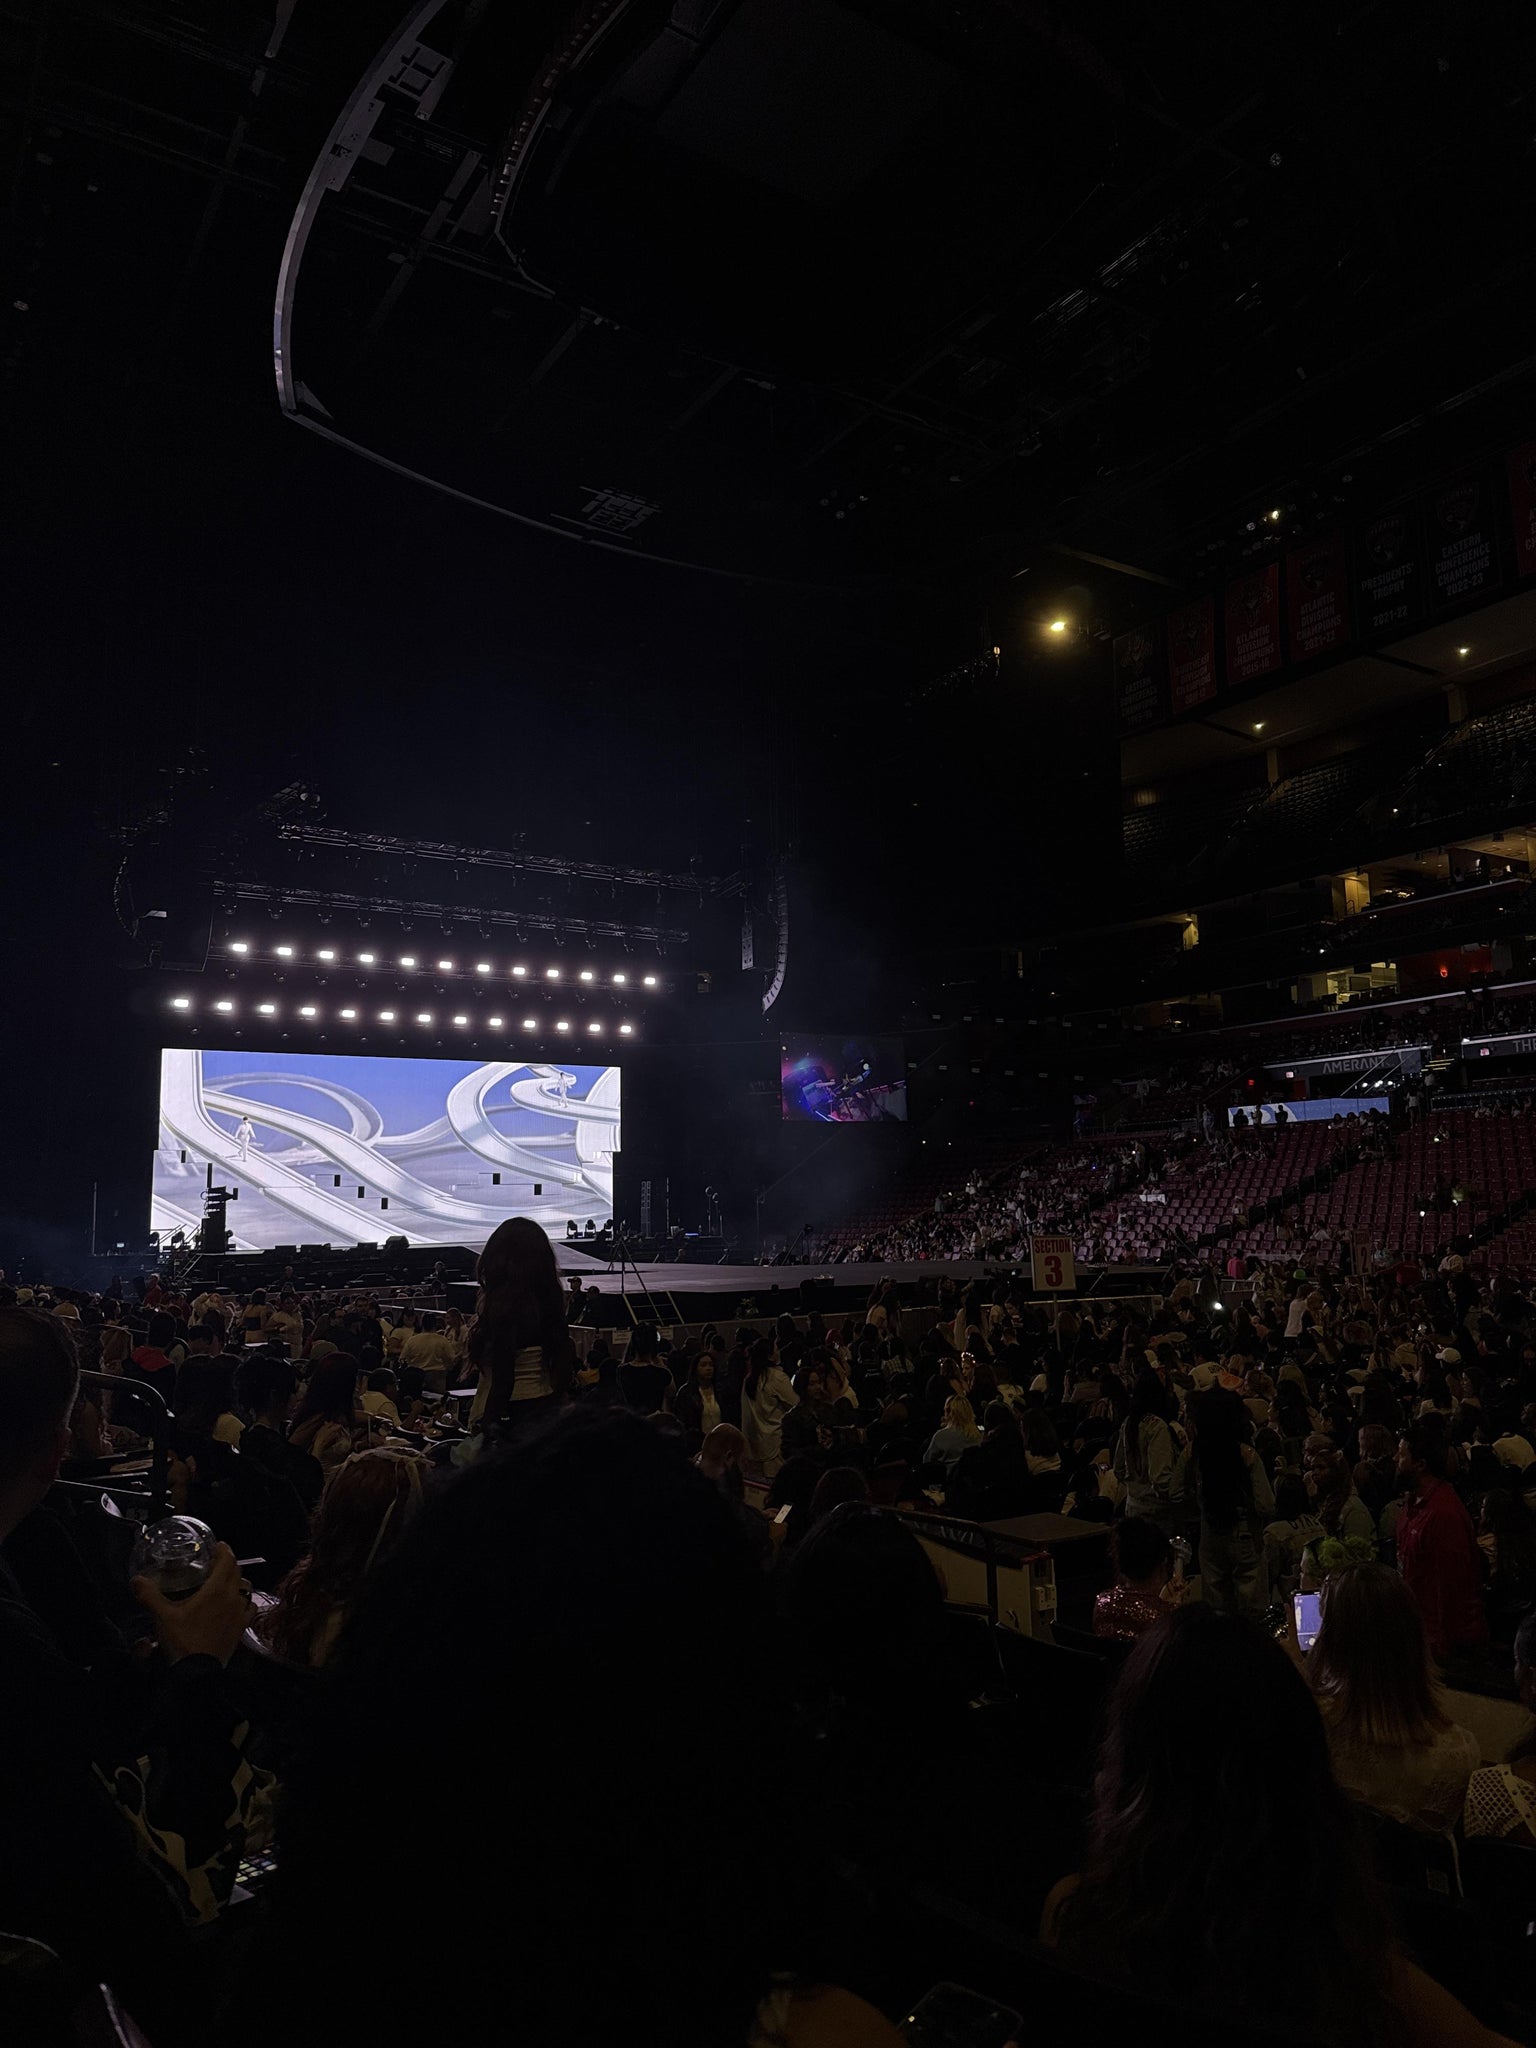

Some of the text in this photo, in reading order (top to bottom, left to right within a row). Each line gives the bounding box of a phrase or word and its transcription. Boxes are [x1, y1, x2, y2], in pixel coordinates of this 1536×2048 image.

[1442, 532, 1481, 559] EASTERN
[1435, 541, 1490, 576] CONFERENCE
[1438, 558, 1490, 588] CHAMPIONS
[1373, 580, 1405, 601] TROPHY
[1373, 604, 1408, 627] 2021-22
[1322, 1055, 1386, 1074] AMERANT
[1034, 1239, 1071, 1254] SECTION
[1044, 1255, 1063, 1287] 3
